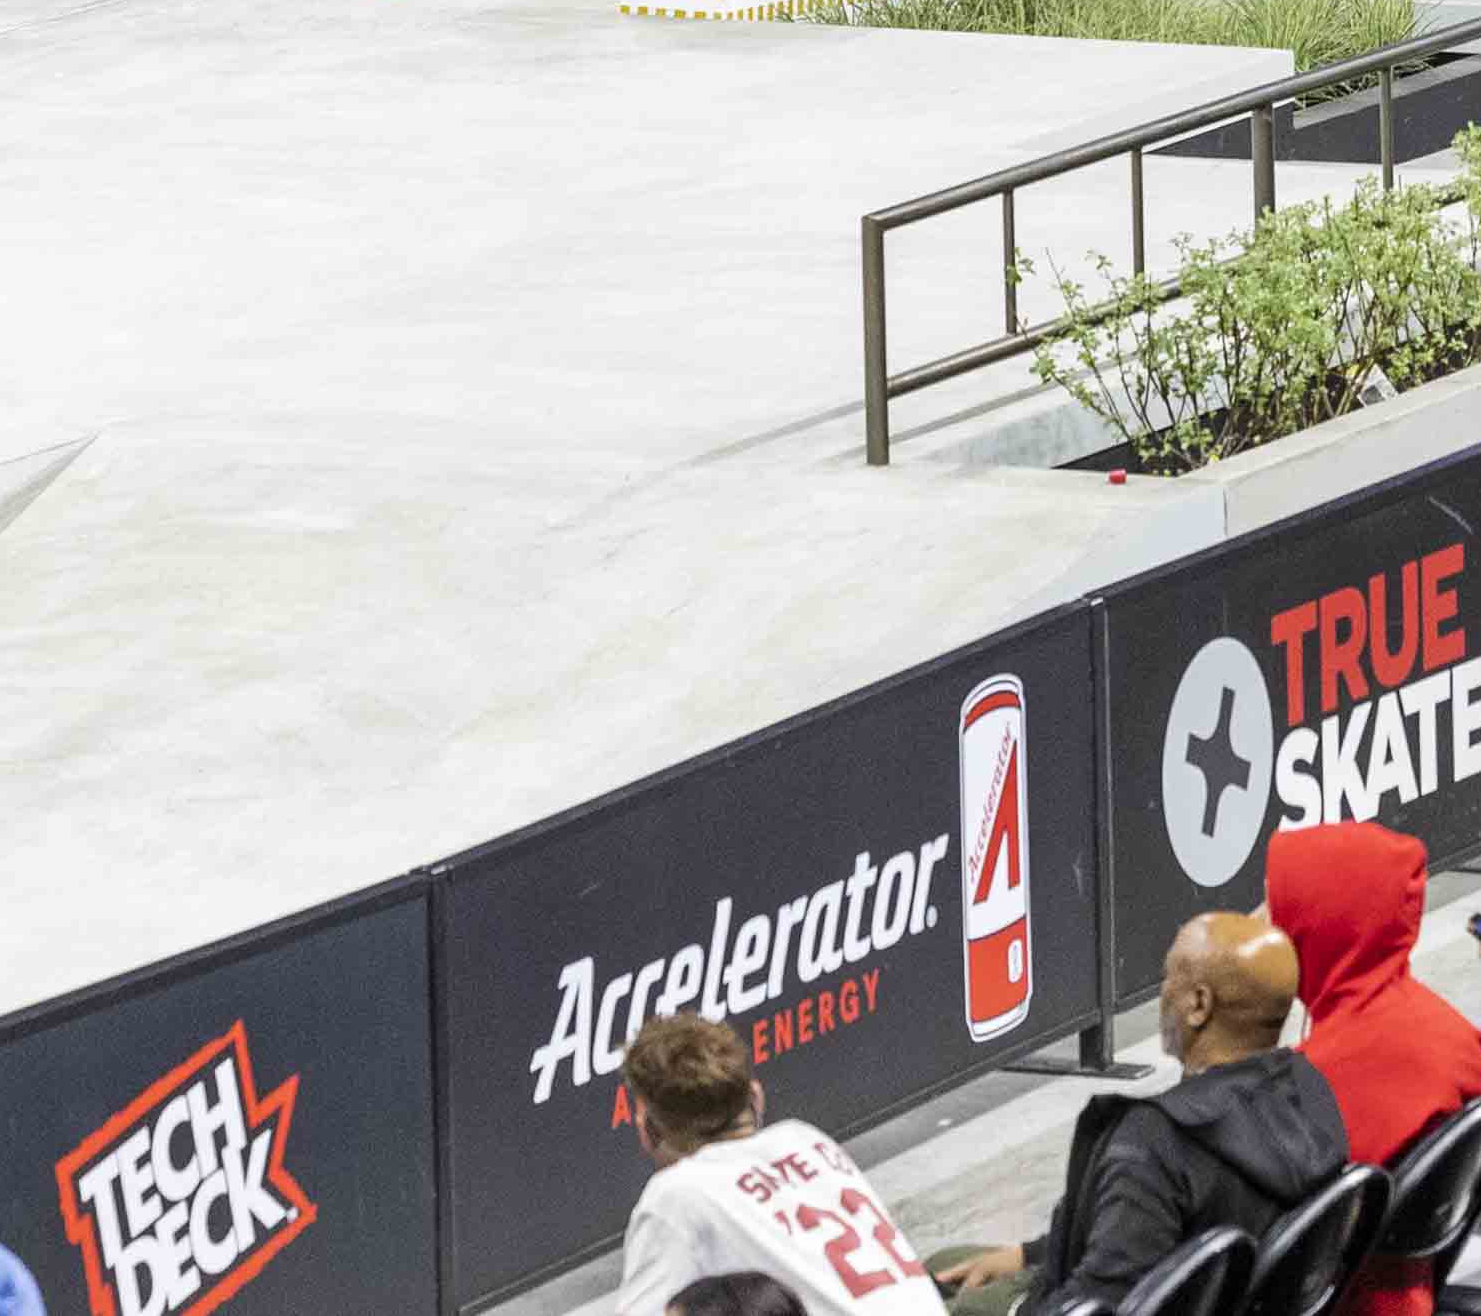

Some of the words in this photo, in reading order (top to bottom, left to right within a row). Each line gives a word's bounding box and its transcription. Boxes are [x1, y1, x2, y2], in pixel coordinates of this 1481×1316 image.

[1270, 543, 1466, 728] TRUE
[752, 969, 879, 1065] ENERGY
[78, 1057, 249, 1268] TECH
